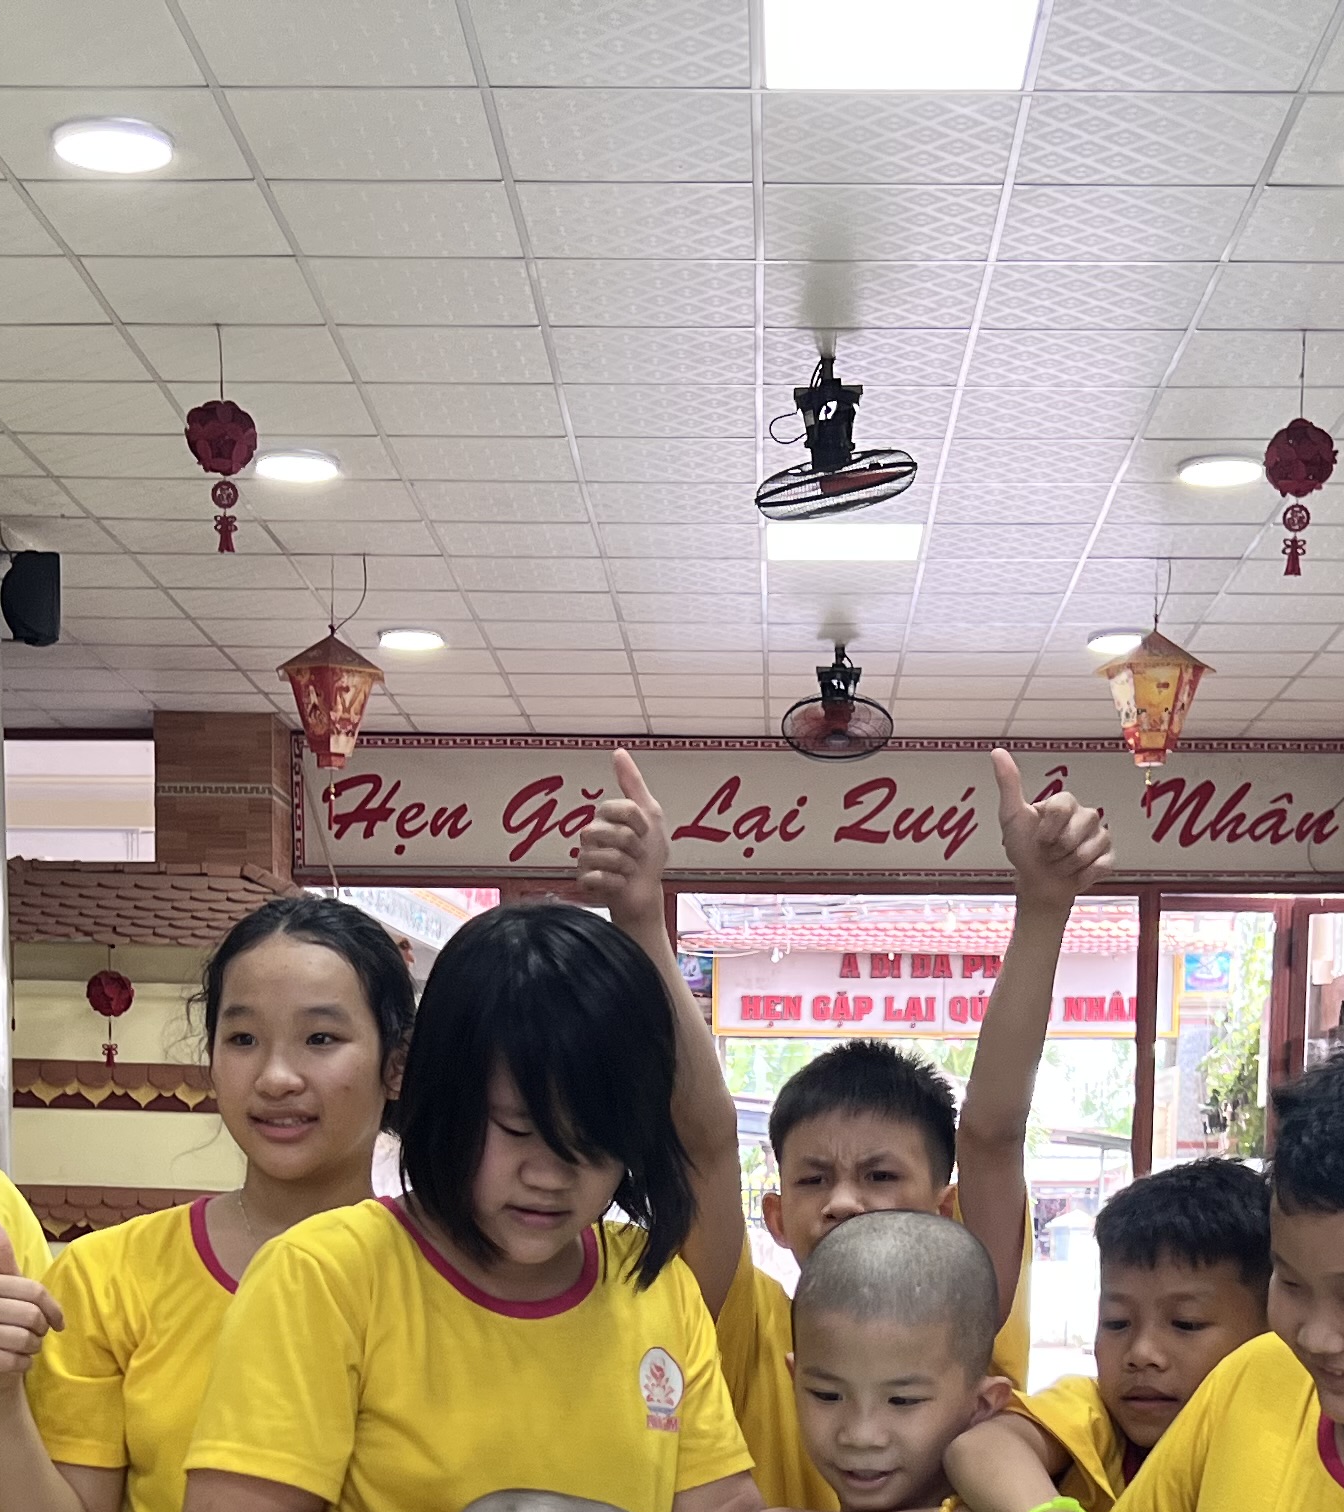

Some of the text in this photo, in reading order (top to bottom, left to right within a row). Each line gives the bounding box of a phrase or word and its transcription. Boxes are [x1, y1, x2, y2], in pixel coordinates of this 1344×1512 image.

[322, 773, 473, 856] Hẹn
[502, 775, 604, 862] Gặ
[671, 775, 808, 859] Lại
[833, 776, 979, 861] Quý
[1141, 776, 1340, 848] Nhân
[740, 994, 803, 1029] HẸN
[812, 990, 874, 1029] GẶP
[883, 995, 937, 1029] LẠI
[948, 989, 992, 1024] QÚ
